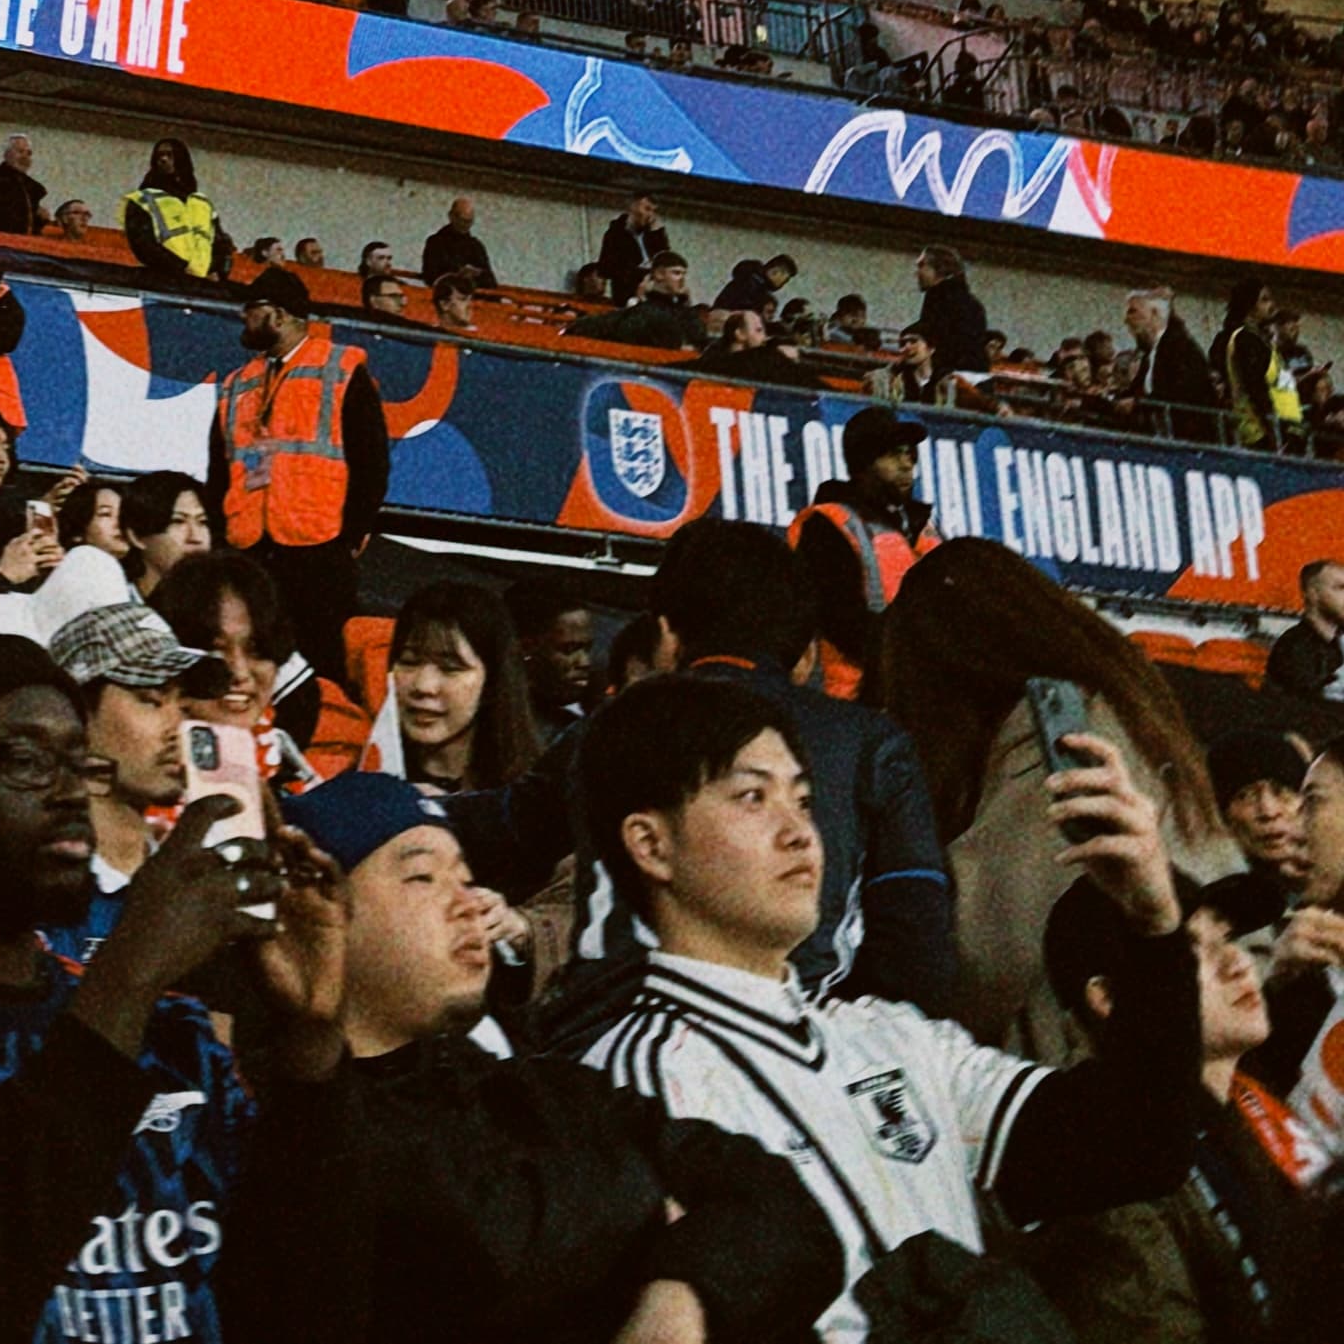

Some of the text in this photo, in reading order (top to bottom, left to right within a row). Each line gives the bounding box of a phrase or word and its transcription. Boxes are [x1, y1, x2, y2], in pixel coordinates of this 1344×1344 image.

[710, 406, 794, 528] THE
[993, 445, 1180, 574] ENGLAND
[1185, 469, 1265, 582] APP
[66, 1200, 222, 1275] ates
